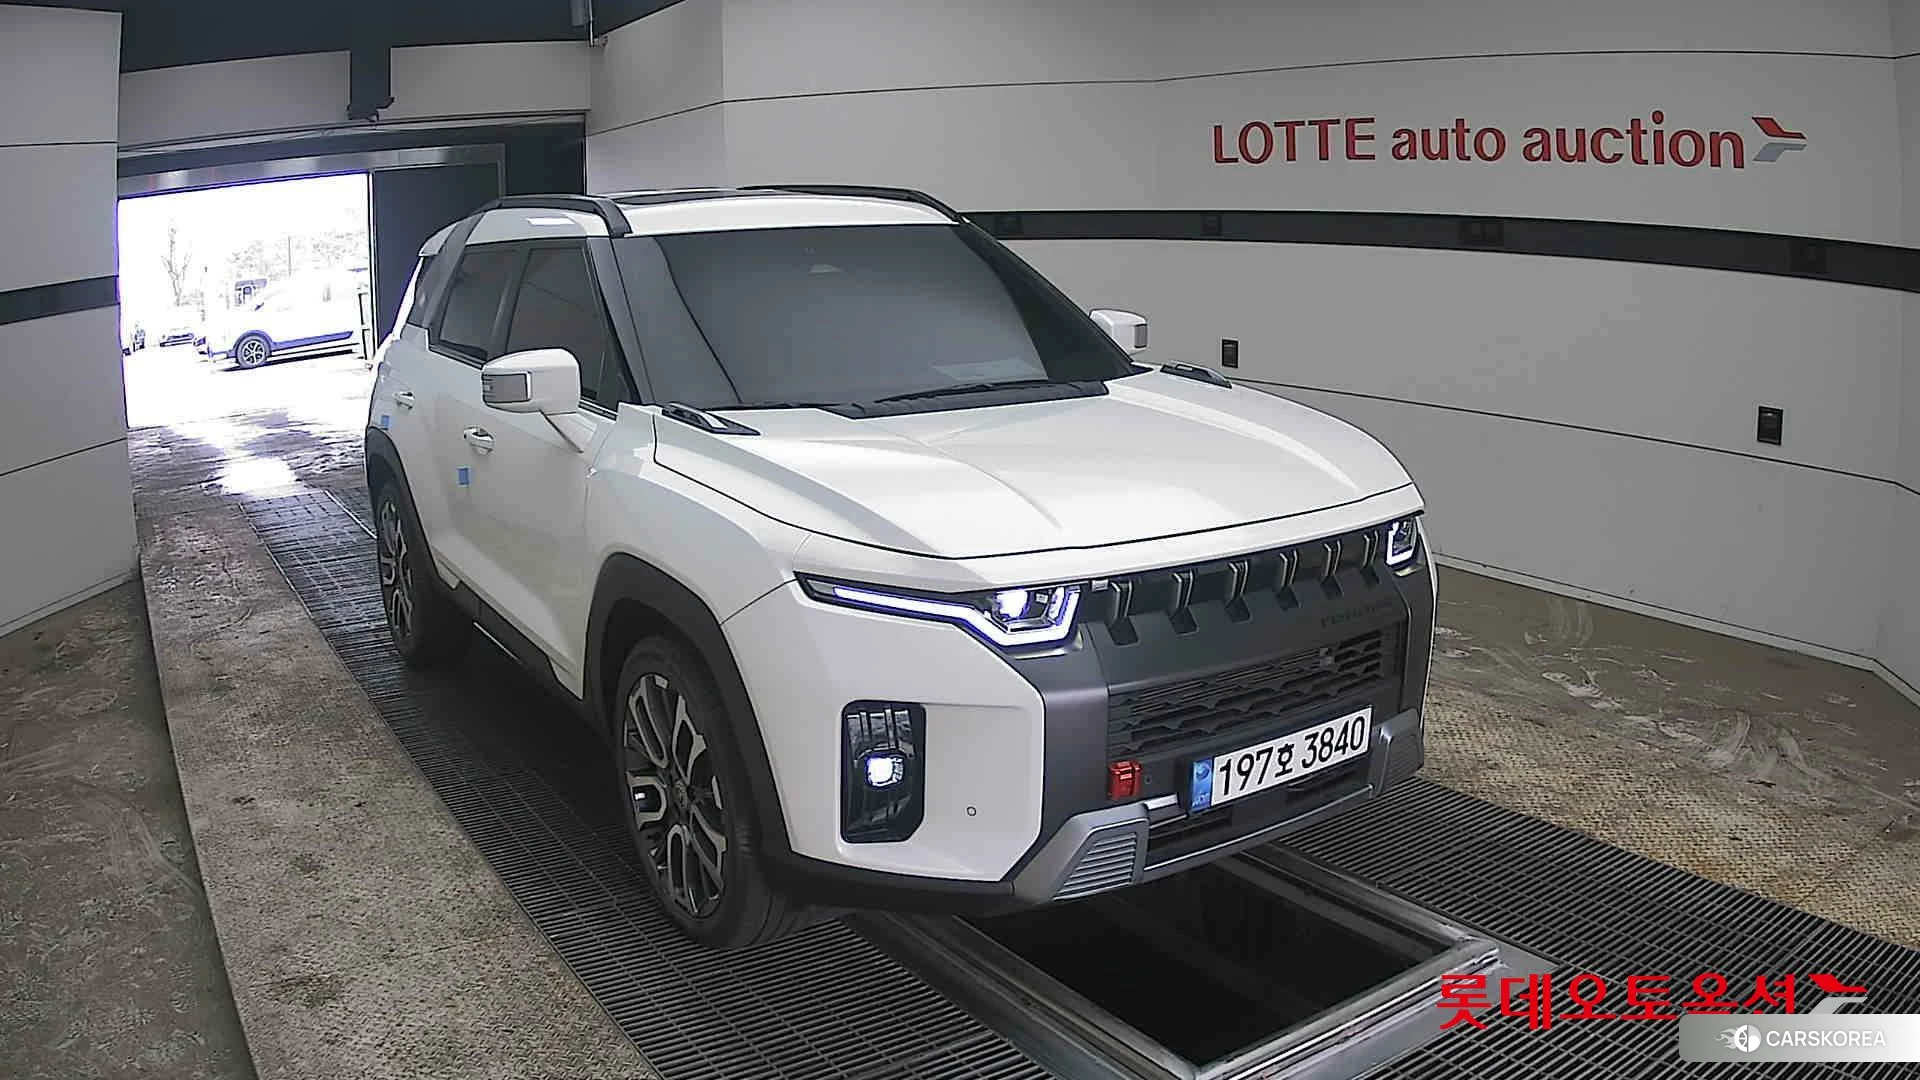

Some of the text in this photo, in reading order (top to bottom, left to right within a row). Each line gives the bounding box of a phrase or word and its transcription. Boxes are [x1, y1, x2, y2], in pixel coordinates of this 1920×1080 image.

[1212, 110, 1746, 169] LOTTE auto auction
[1219, 716, 1365, 796] 197호 3840
